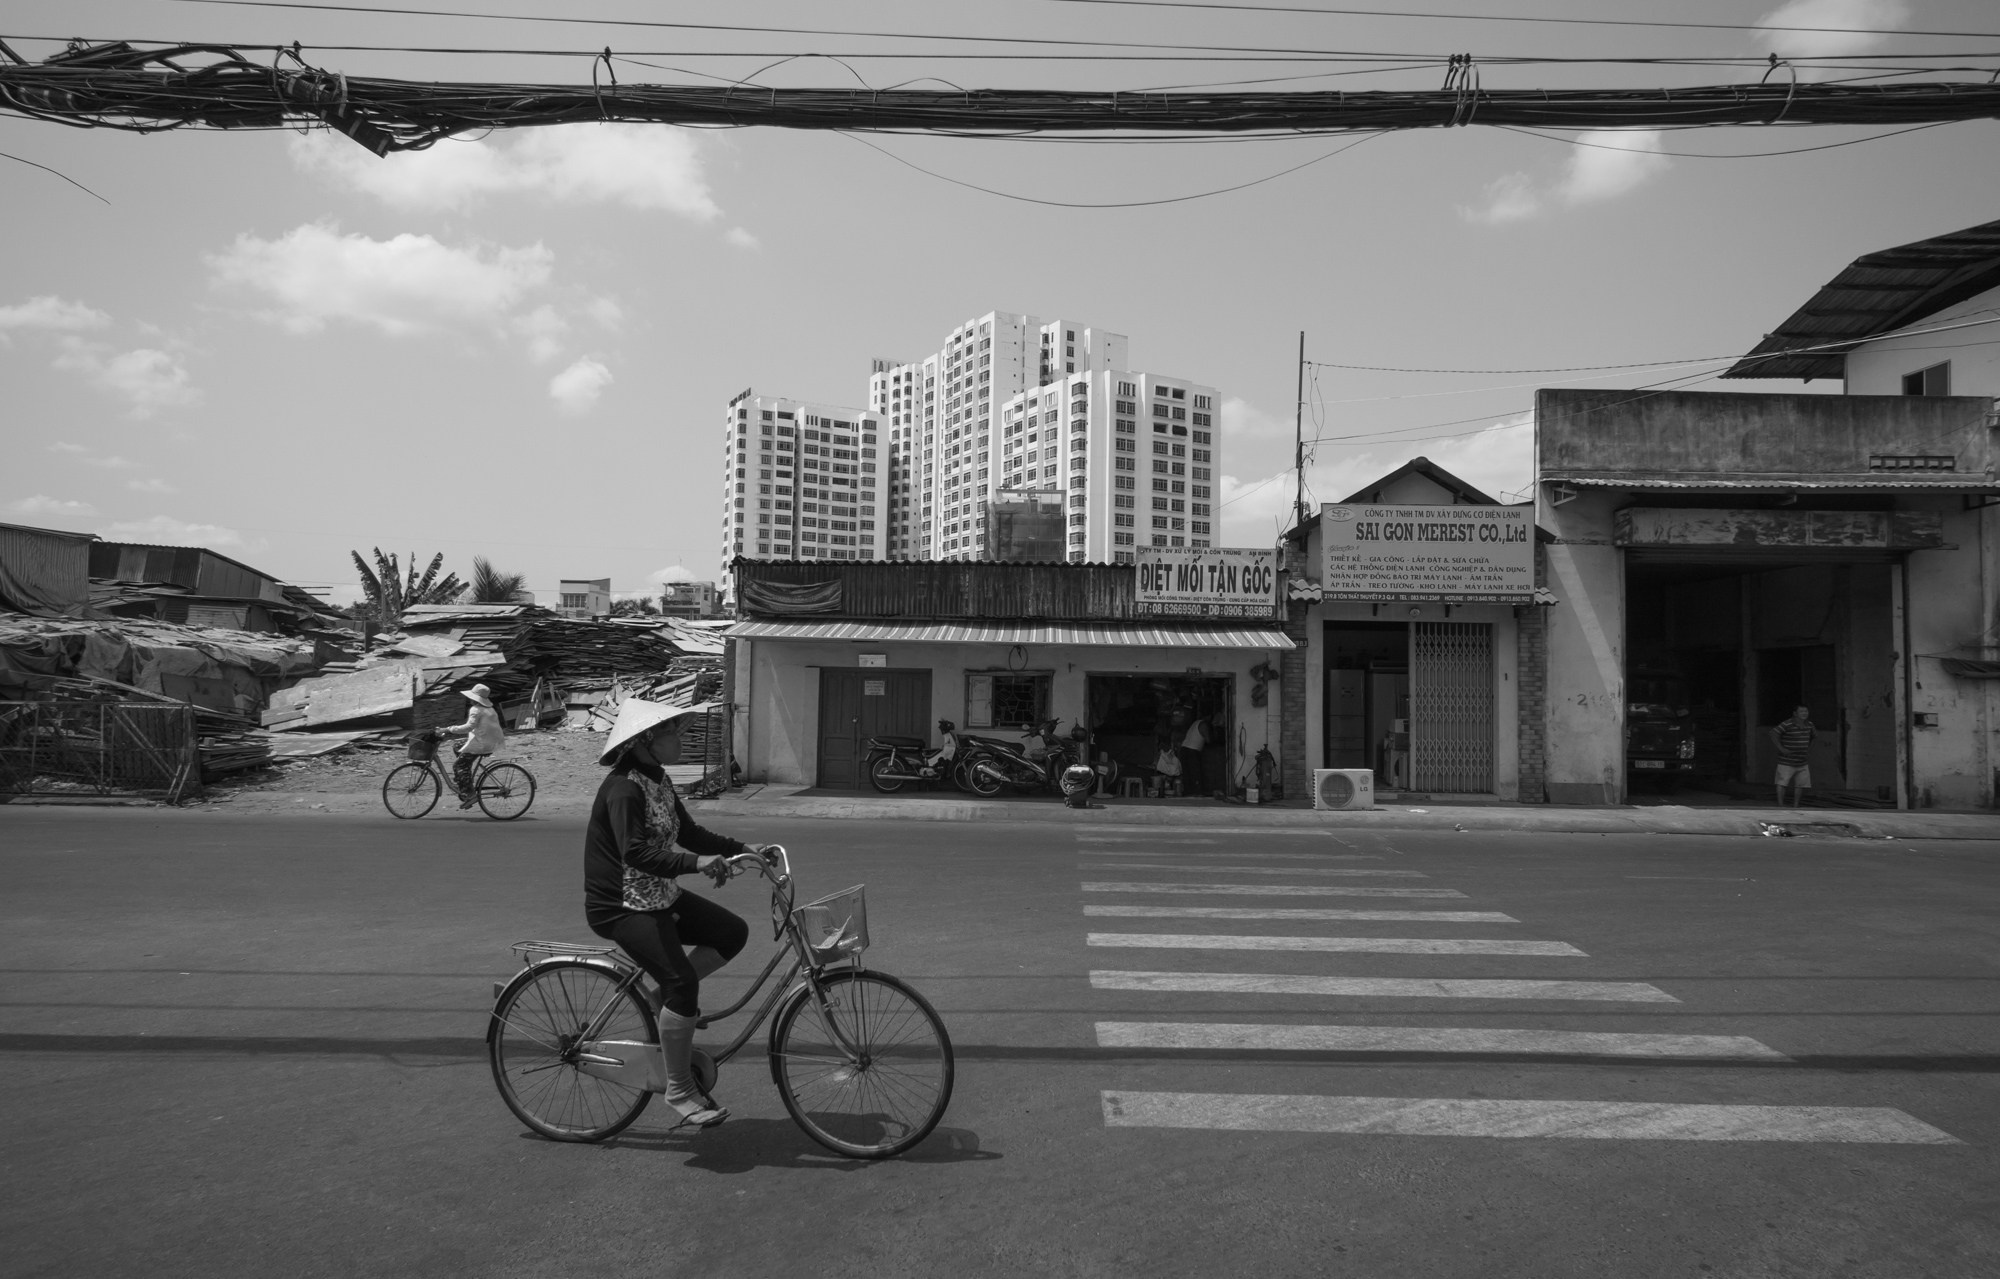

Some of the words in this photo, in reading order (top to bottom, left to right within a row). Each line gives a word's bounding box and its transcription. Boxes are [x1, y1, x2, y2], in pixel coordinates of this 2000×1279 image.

[1364, 508, 1384, 518] CÔNG
[1437, 508, 1451, 518] XÂY
[1452, 510, 1472, 520] DỰNG
[1502, 511, 1521, 520] LẠNH
[1356, 522, 1380, 541] SAI
[1384, 522, 1414, 542] GON
[1417, 523, 1475, 542] MEREST
[1479, 523, 1527, 544] CO.,Ltd
[1352, 554, 1361, 562] KẾ
[1347, 563, 1357, 572] HỆ
[1360, 563, 1384, 571] THỐNG
[1452, 565, 1478, 573] NGHIỆP
[1141, 557, 1172, 595] DIỆT
[1177, 555, 1204, 592] MỐI
[1208, 559, 1237, 597] TẬN
[1242, 557, 1271, 594] GỐC
[1330, 572, 1352, 580] NHẬN
[1164, 604, 1201, 615] 62669500
[1244, 606, 1272, 617] 385989
